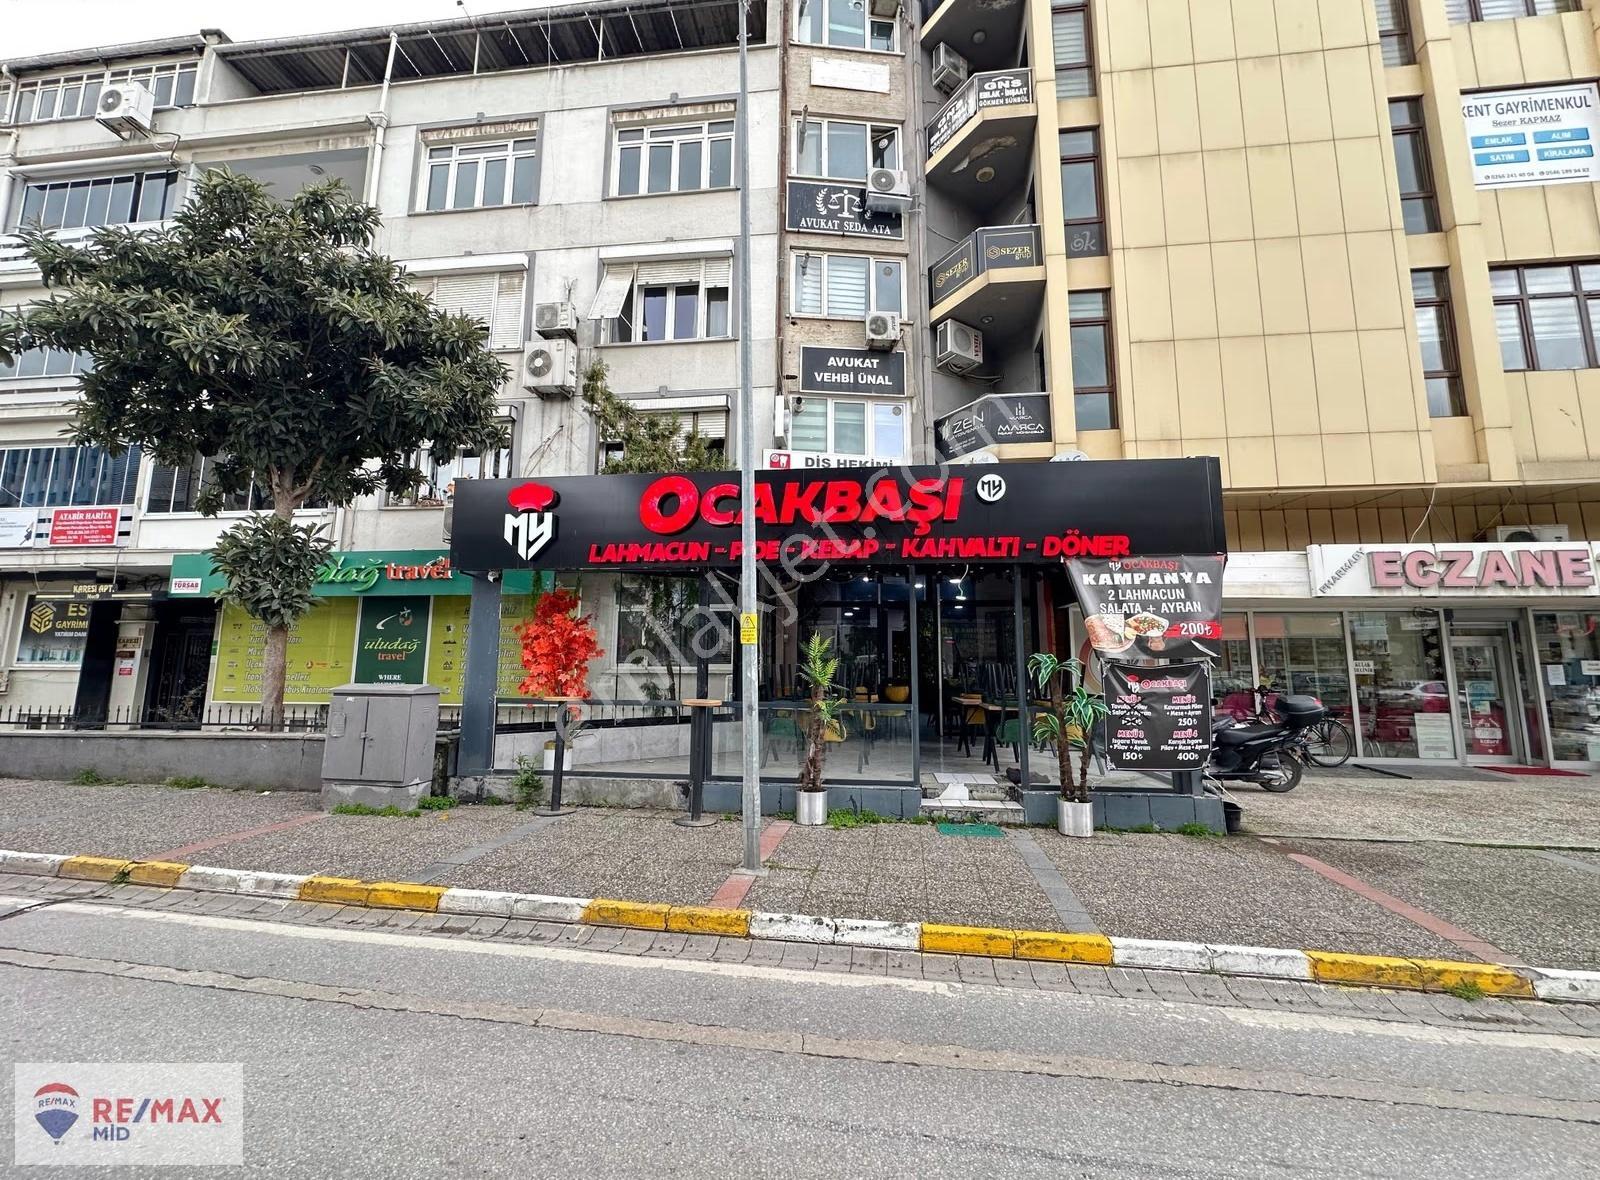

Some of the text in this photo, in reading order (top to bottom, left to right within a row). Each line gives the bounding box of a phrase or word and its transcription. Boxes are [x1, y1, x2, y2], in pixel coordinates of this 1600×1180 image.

[984, 79, 1022, 90] GNS
[1495, 95, 1591, 116] GAYRİMENKUL
[1492, 115, 1561, 127] Sezer KAPMAZ
[1485, 132, 1572, 144] EMLAK ALIM
[1490, 153, 1515, 161] SATIM
[800, 218, 891, 235] AVUKAT SEDA ATA
[1000, 246, 1031, 256] SEZER
[827, 356, 880, 369] AVUKAT
[814, 370, 893, 386] VEHBİ ÜNAL
[953, 411, 984, 434] ZEN
[998, 424, 1045, 432] MARCA
[640, 475, 965, 536] OCAKBAŞI
[59, 511, 112, 520] ATABİR HARİTA
[589, 543, 711, 563] LAHMACUN
[729, 537, 781, 561] PDE
[902, 536, 1021, 559] KAHVALTI
[1043, 529, 1130, 558] DÖNER
[386, 556, 453, 580] travel
[1123, 560, 1180, 571] OCAKBAŞI
[1367, 550, 1595, 588] ECZANE
[1082, 572, 1212, 586] KAMPANYA
[1108, 588, 1185, 601] 2 LAHMACUN
[1100, 602, 1142, 614] SALATA
[1161, 601, 1202, 613] AYRAN
[364, 637, 421, 653] uludağ
[378, 651, 406, 660] travel
